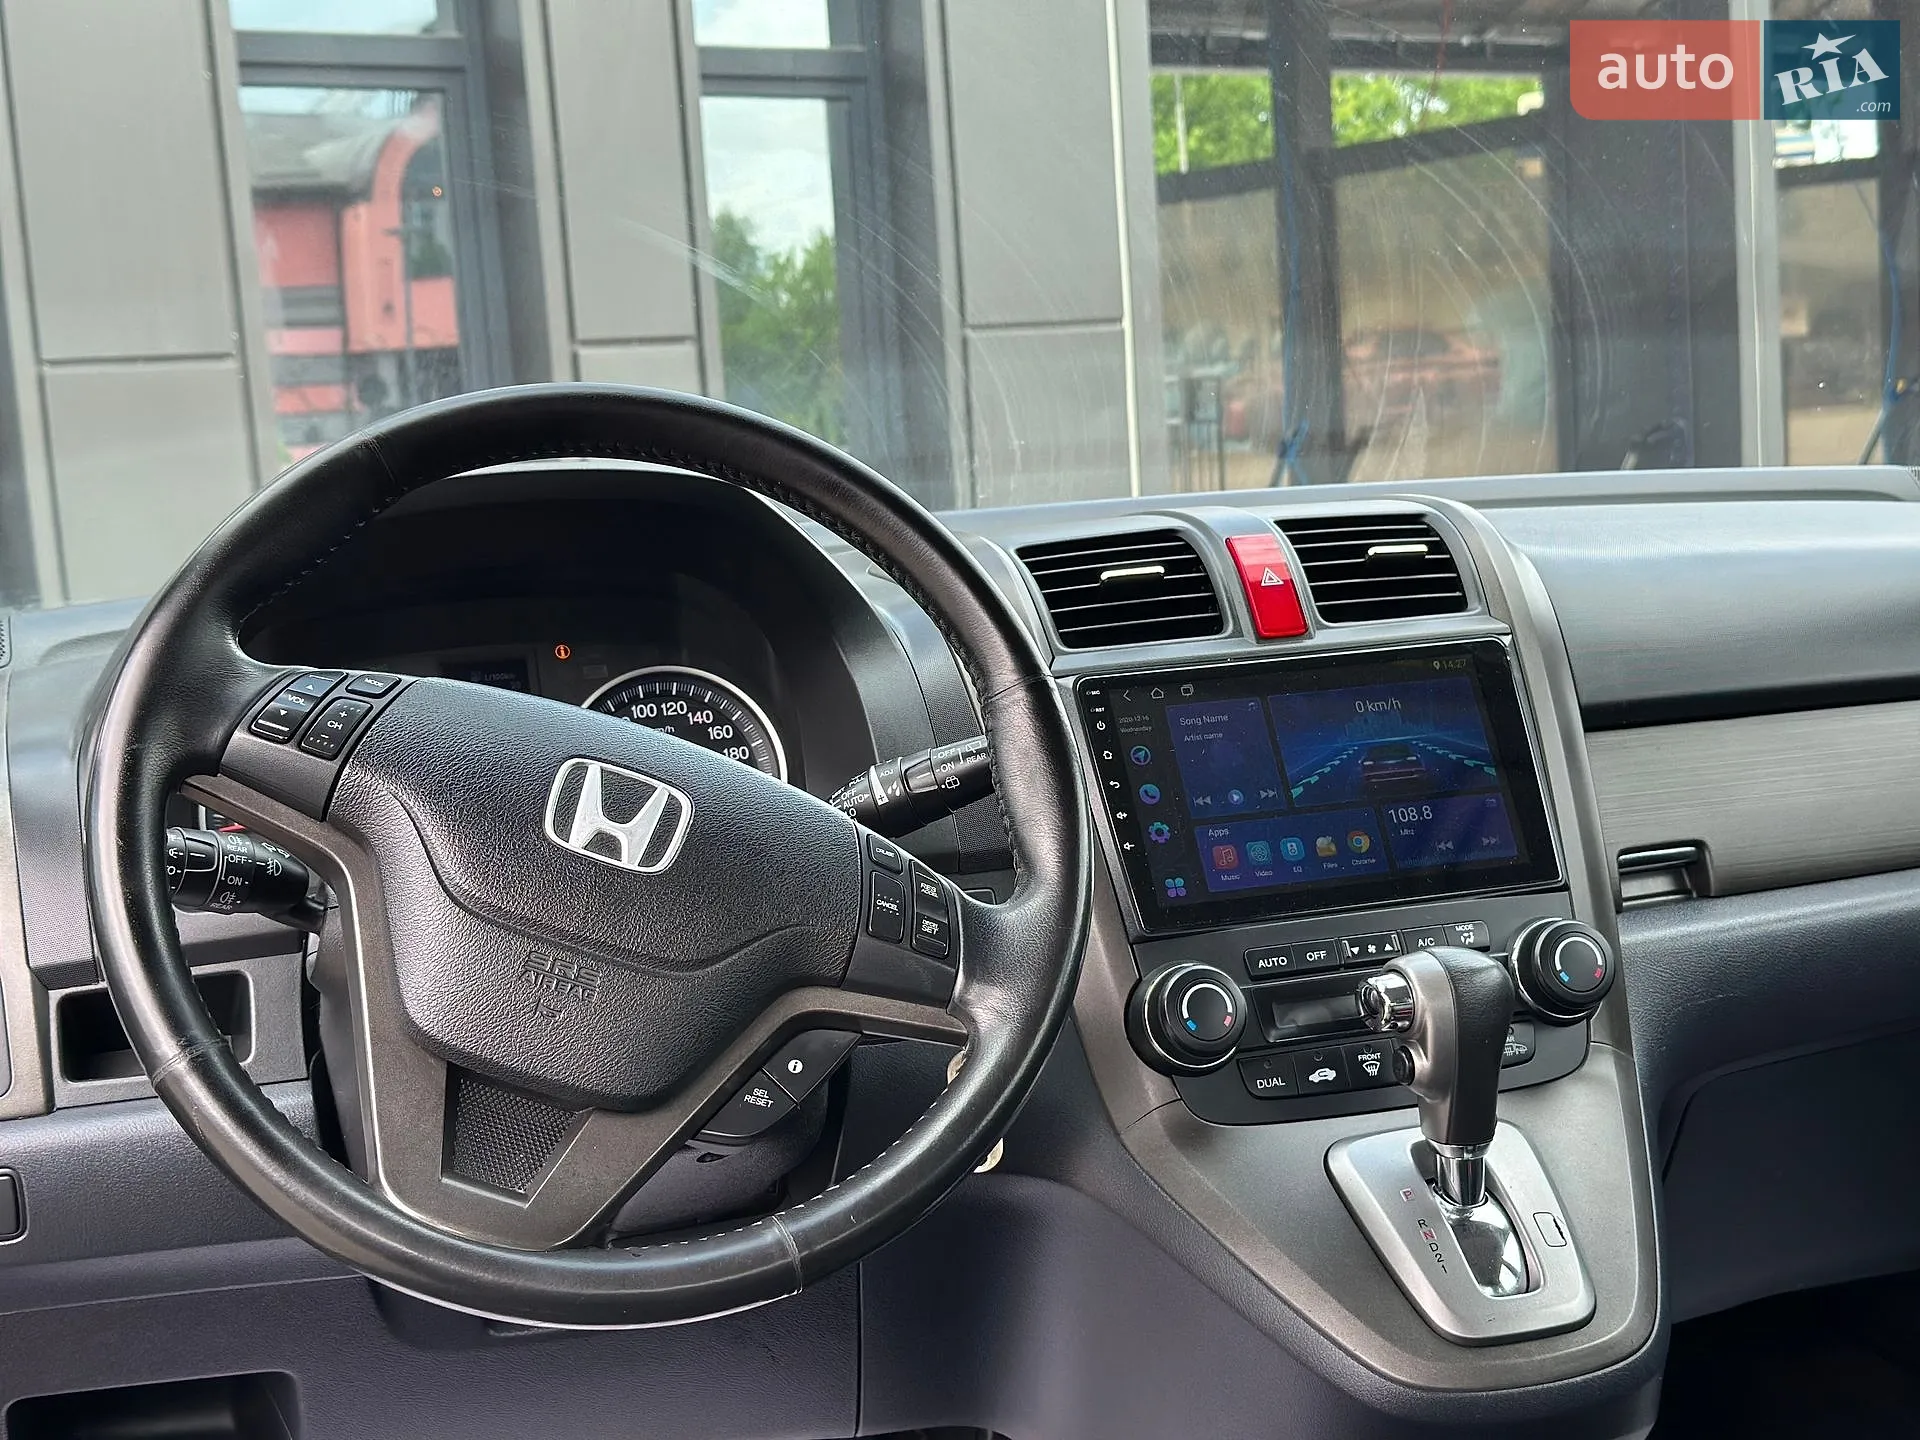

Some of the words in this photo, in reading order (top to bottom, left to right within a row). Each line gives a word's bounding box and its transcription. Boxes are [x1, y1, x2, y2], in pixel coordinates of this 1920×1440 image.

[364, 677, 384, 688] MODE
[288, 694, 306, 706] VOL
[1366, 698, 1401, 712] km/h
[631, 703, 657, 719] 100
[661, 700, 688, 716] 120
[687, 710, 714, 726] 140
[1179, 717, 1202, 727] Song
[1203, 714, 1229, 724] Name
[327, 720, 343, 731] CH
[707, 724, 734, 740] 160
[722, 746, 750, 760] 180
[937, 750, 955, 759] OFF
[966, 752, 987, 765] REAR
[940, 762, 955, 772] ON
[880, 769, 894, 778] ADJ
[841, 788, 857, 801] OFF
[843, 794, 864, 810] AUTO
[1388, 805, 1433, 824] 108.8
[1208, 828, 1230, 838] Apps
[227, 844, 248, 853] REAR
[228, 854, 247, 864] OFF
[1351, 858, 1376, 866] Chrome
[1322, 862, 1339, 870] Files
[227, 875, 243, 886] ON
[210, 902, 232, 910] REAR
[876, 899, 899, 911] CANCEL
[921, 925, 939, 935] SET
[1417, 937, 1435, 947] A/C
[1306, 950, 1327, 962] OFF
[1258, 956, 1288, 969] AUTO
[525, 951, 602, 990] SRS
[519, 970, 599, 1001] AIRBAG
[1358, 1052, 1381, 1062] FRONT
[1256, 1077, 1286, 1089] DUAL
[752, 1088, 769, 1099] SEL
[743, 1095, 774, 1108] RESET
[1403, 1190, 1413, 1200] P
[1417, 1219, 1428, 1229] R
[1423, 1231, 1435, 1240] N
[1429, 1242, 1439, 1252] D
[1435, 1253, 1444, 1262] 2
[1441, 1264, 1447, 1274] 1
